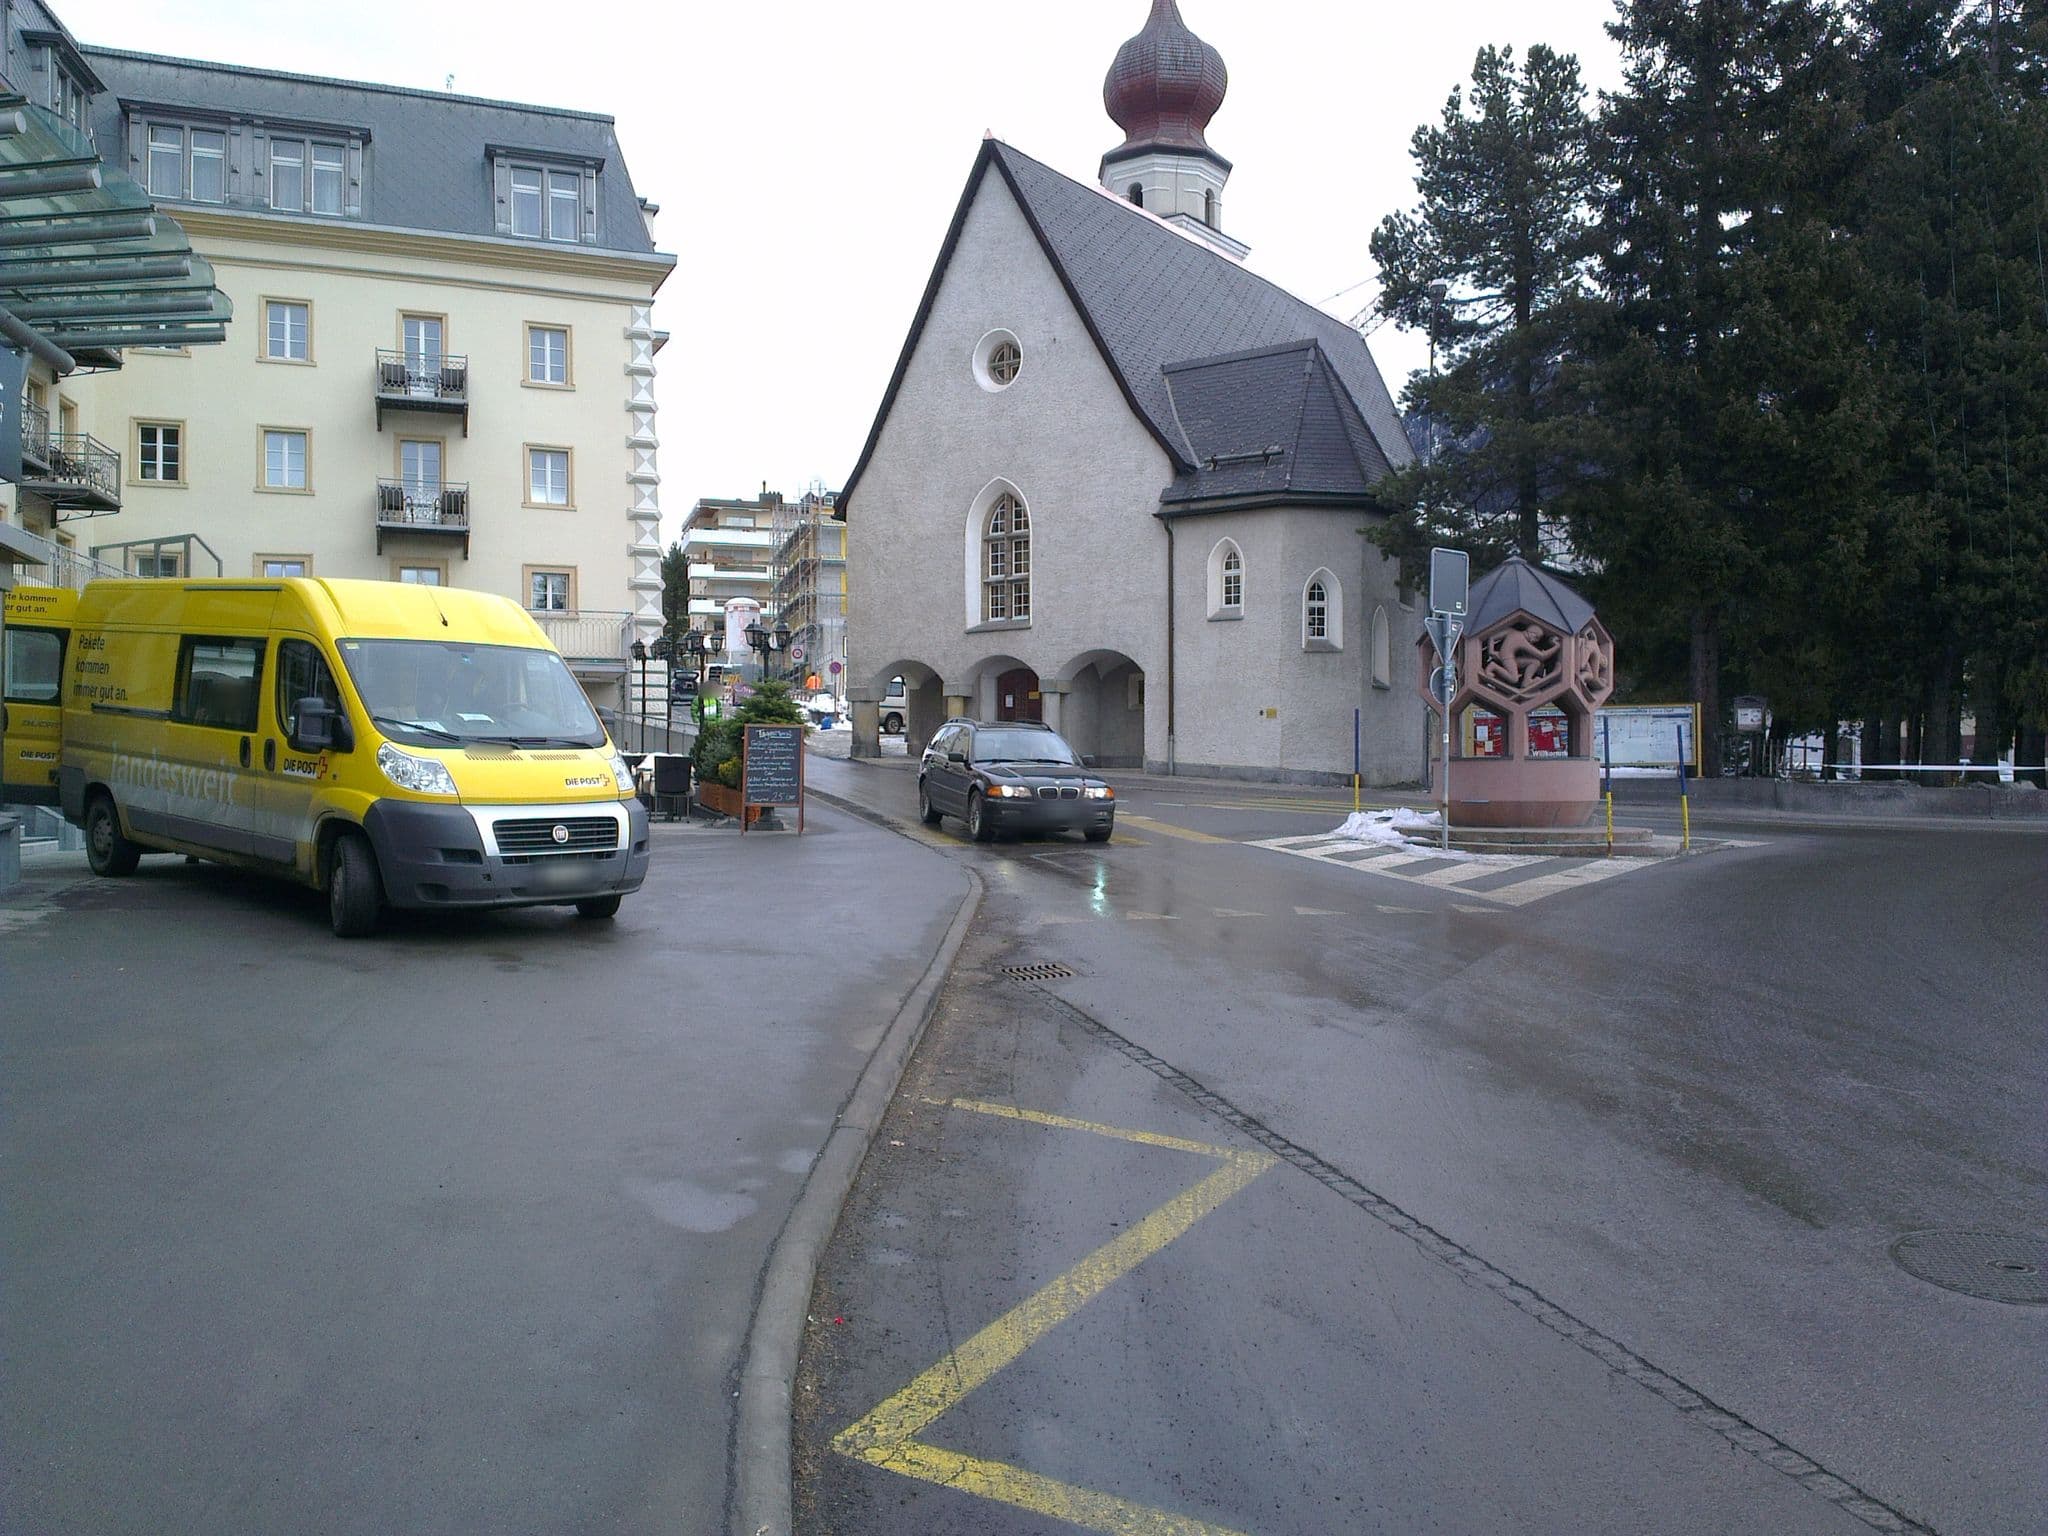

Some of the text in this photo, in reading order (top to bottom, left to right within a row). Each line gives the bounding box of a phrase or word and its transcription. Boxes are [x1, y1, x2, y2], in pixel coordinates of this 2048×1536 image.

[19, 593, 58, 603] kommen
[16, 605, 32, 613] gut
[79, 633, 105, 650] Pakete
[75, 656, 110, 674] kommen
[73, 680, 98, 698] immer
[99, 685, 114, 703] gut
[21, 750, 56, 759] DIE POST
[111, 741, 238, 803] landesweit
[284, 758, 318, 776] DIE POST
[565, 777, 600, 786] DIE POST
